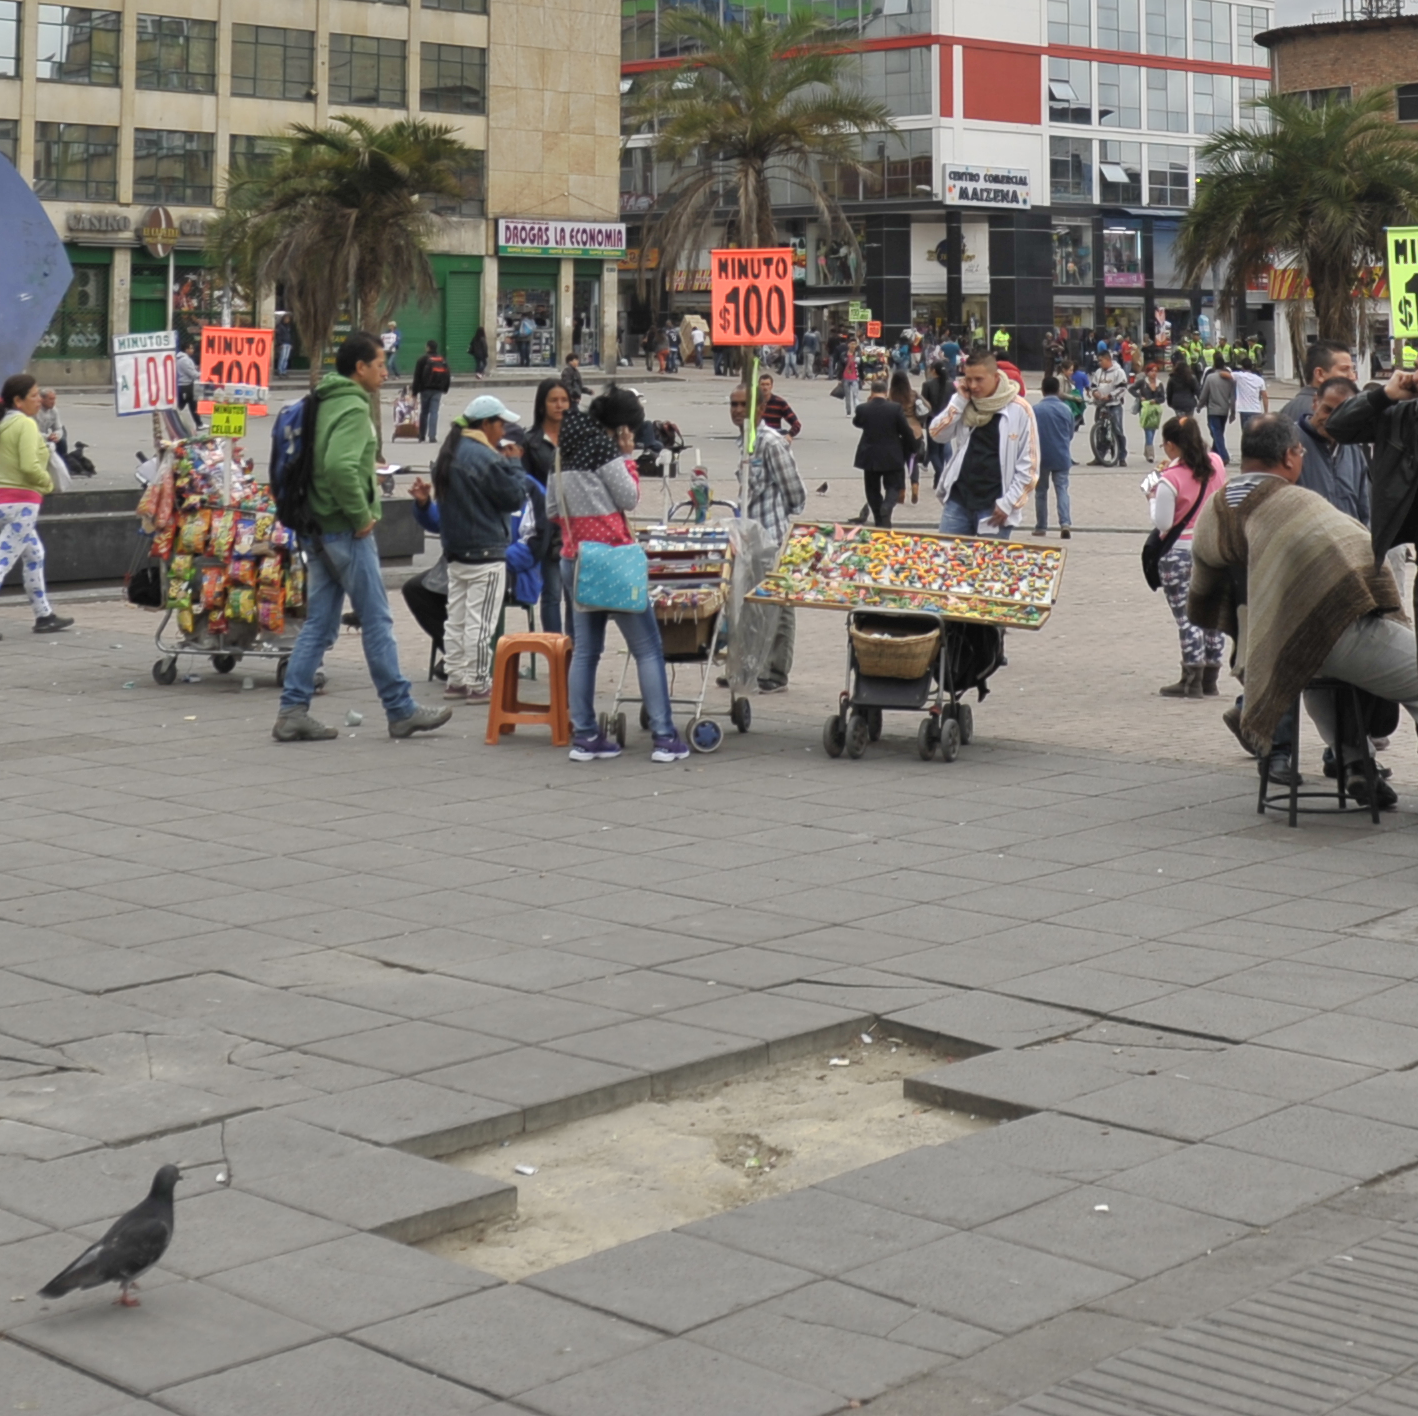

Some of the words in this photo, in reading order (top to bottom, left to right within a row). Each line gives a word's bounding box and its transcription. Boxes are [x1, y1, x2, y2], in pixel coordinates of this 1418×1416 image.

[948, 170, 980, 183] CENTRO
[984, 172, 1029, 186] COMERCIAL
[958, 186, 1020, 204] MAIZENA
[66, 213, 131, 232] CASINO
[504, 224, 550, 246] DROGAS
[554, 226, 566, 247] LA
[569, 227, 623, 249] ECONOMIA
[718, 256, 788, 280] MINUTO
[718, 284, 787, 337] $100
[118, 334, 171, 351] MINUTOS
[205, 335, 266, 357] MINUTO
[121, 375, 130, 392] A
[133, 353, 176, 410] 100
[213, 405, 245, 415] MINUTOS
[225, 416, 231, 424] A
[211, 424, 243, 435] CELULAR
